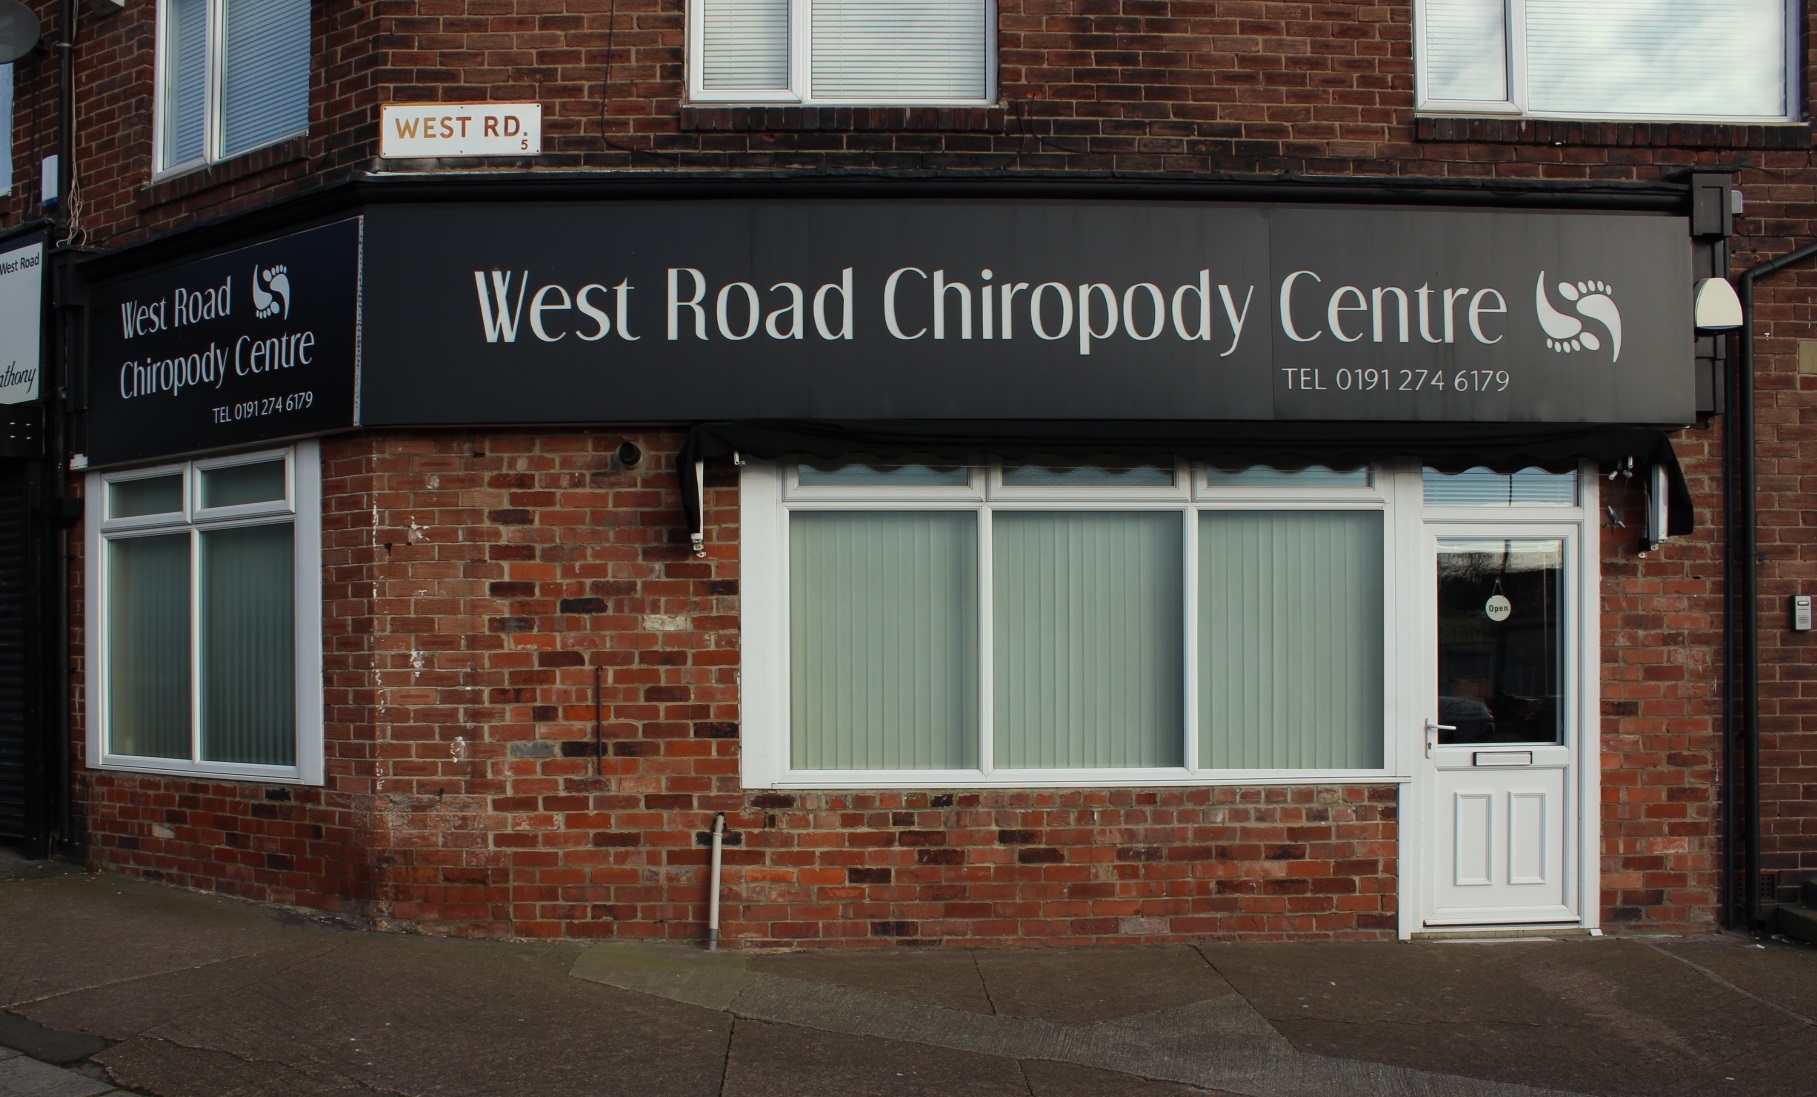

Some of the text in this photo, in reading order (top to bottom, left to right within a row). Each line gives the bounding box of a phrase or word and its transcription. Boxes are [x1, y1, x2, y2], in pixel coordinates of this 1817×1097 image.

[395, 115, 528, 139] WEST RD.
[520, 139, 528, 150] 5
[0, 252, 40, 275] West Road
[121, 275, 232, 340] West Road
[474, 266, 1507, 357] West Road Chiropody Centre
[120, 331, 315, 399] Chiropody Centre
[1281, 368, 1510, 392] TEL 0191 274 6179
[212, 391, 313, 424] TEL 0191 274 6179
[1488, 604, 1509, 613] Open
